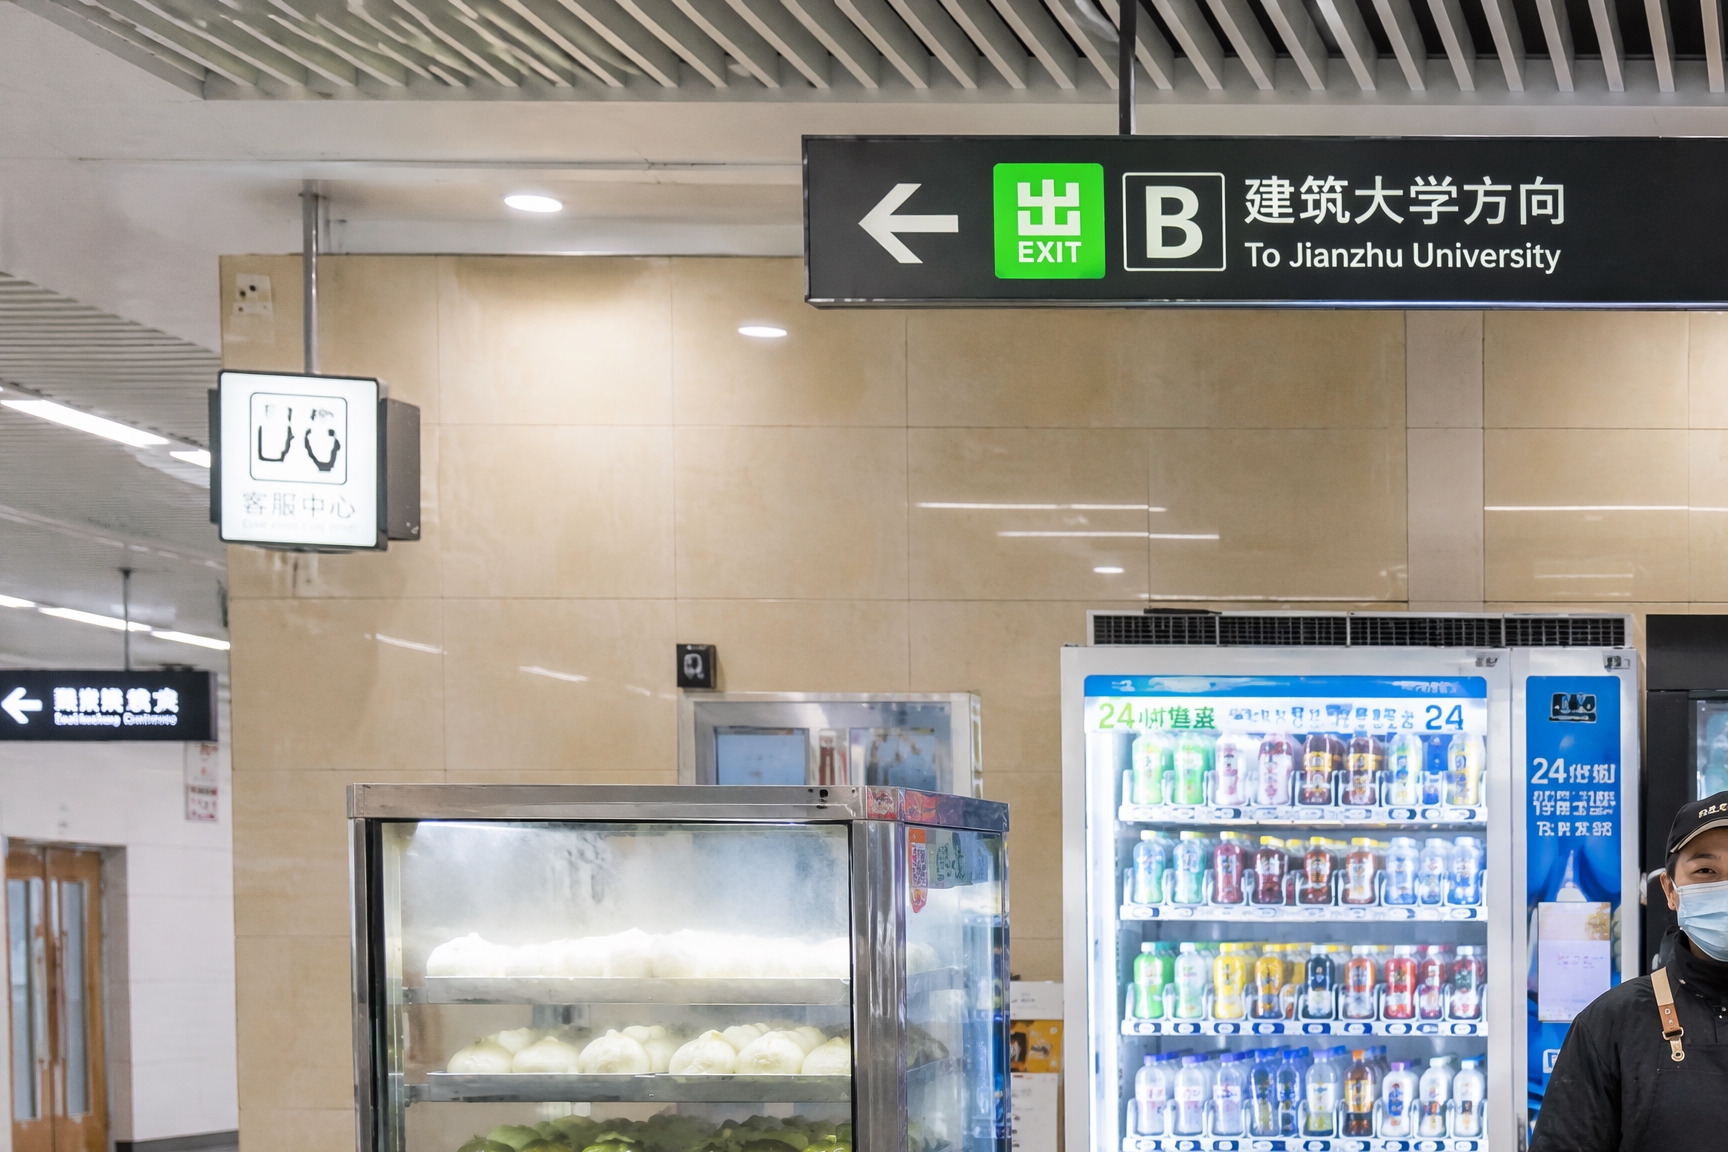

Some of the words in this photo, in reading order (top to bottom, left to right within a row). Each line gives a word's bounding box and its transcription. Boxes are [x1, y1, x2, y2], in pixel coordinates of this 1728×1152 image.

[1017, 179, 1081, 236] 出
[1244, 174, 1565, 226] 建筑大学方向
[1145, 185, 1203, 259] B
[1018, 241, 1082, 263] EXIT
[1244, 242, 1281, 268] To
[1288, 241, 1403, 268] Jianzhu
[1413, 242, 1562, 275] University
[242, 491, 356, 520] 客服中心
[1425, 704, 1464, 731] 24
